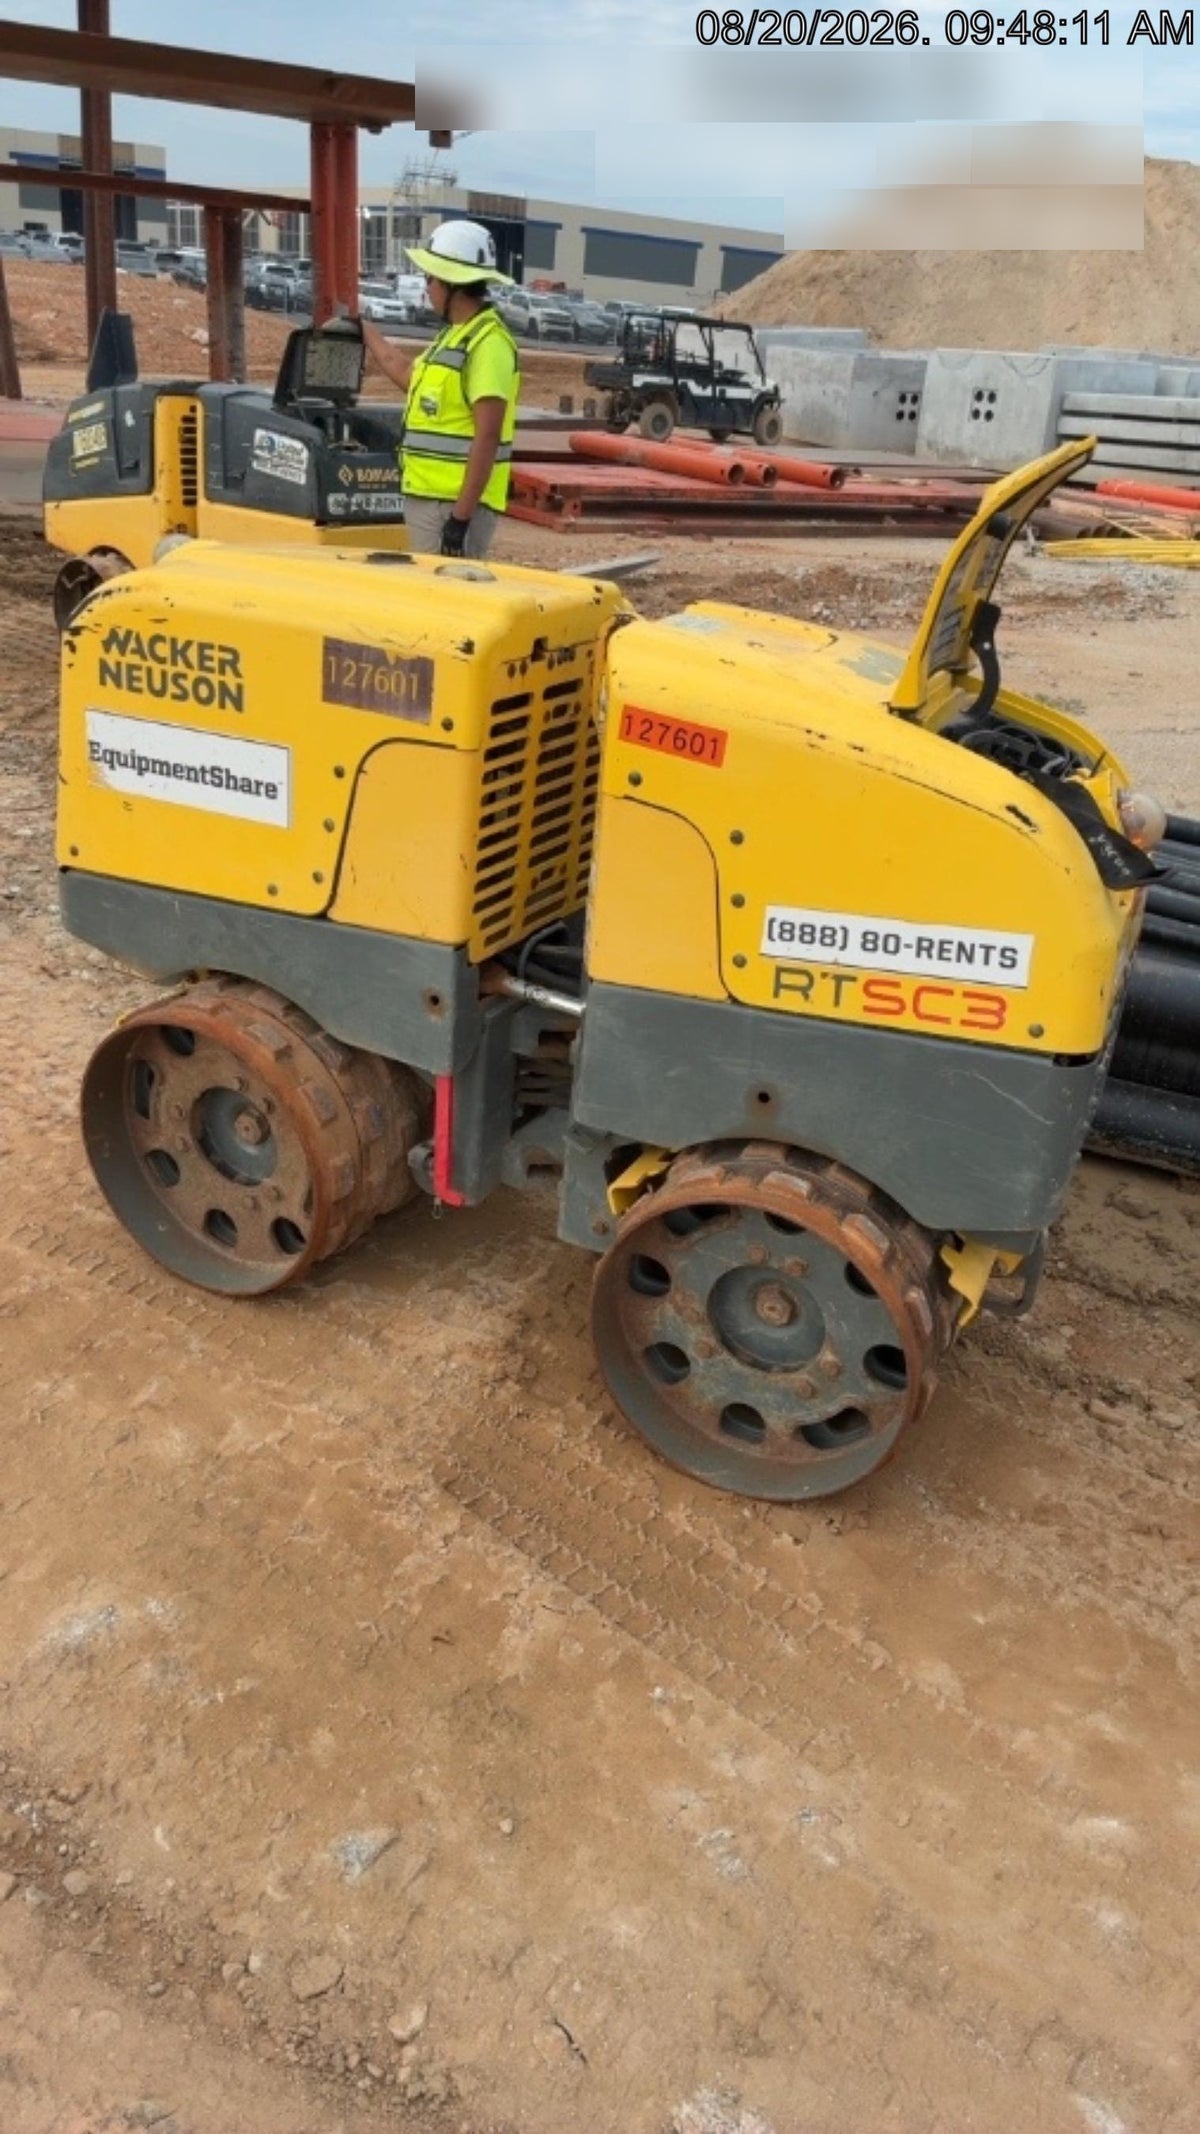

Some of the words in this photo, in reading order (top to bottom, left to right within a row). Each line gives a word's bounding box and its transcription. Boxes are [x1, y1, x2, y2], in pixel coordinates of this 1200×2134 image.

[102, 627, 244, 679] WACKER
[328, 655, 419, 701] 127601
[98, 657, 245, 714] NEUSON
[625, 714, 719, 760] 127601
[88, 739, 279, 800] EquipmentShare
[767, 917, 849, 951] (888)
[860, 930, 1019, 970] 80-RENTS
